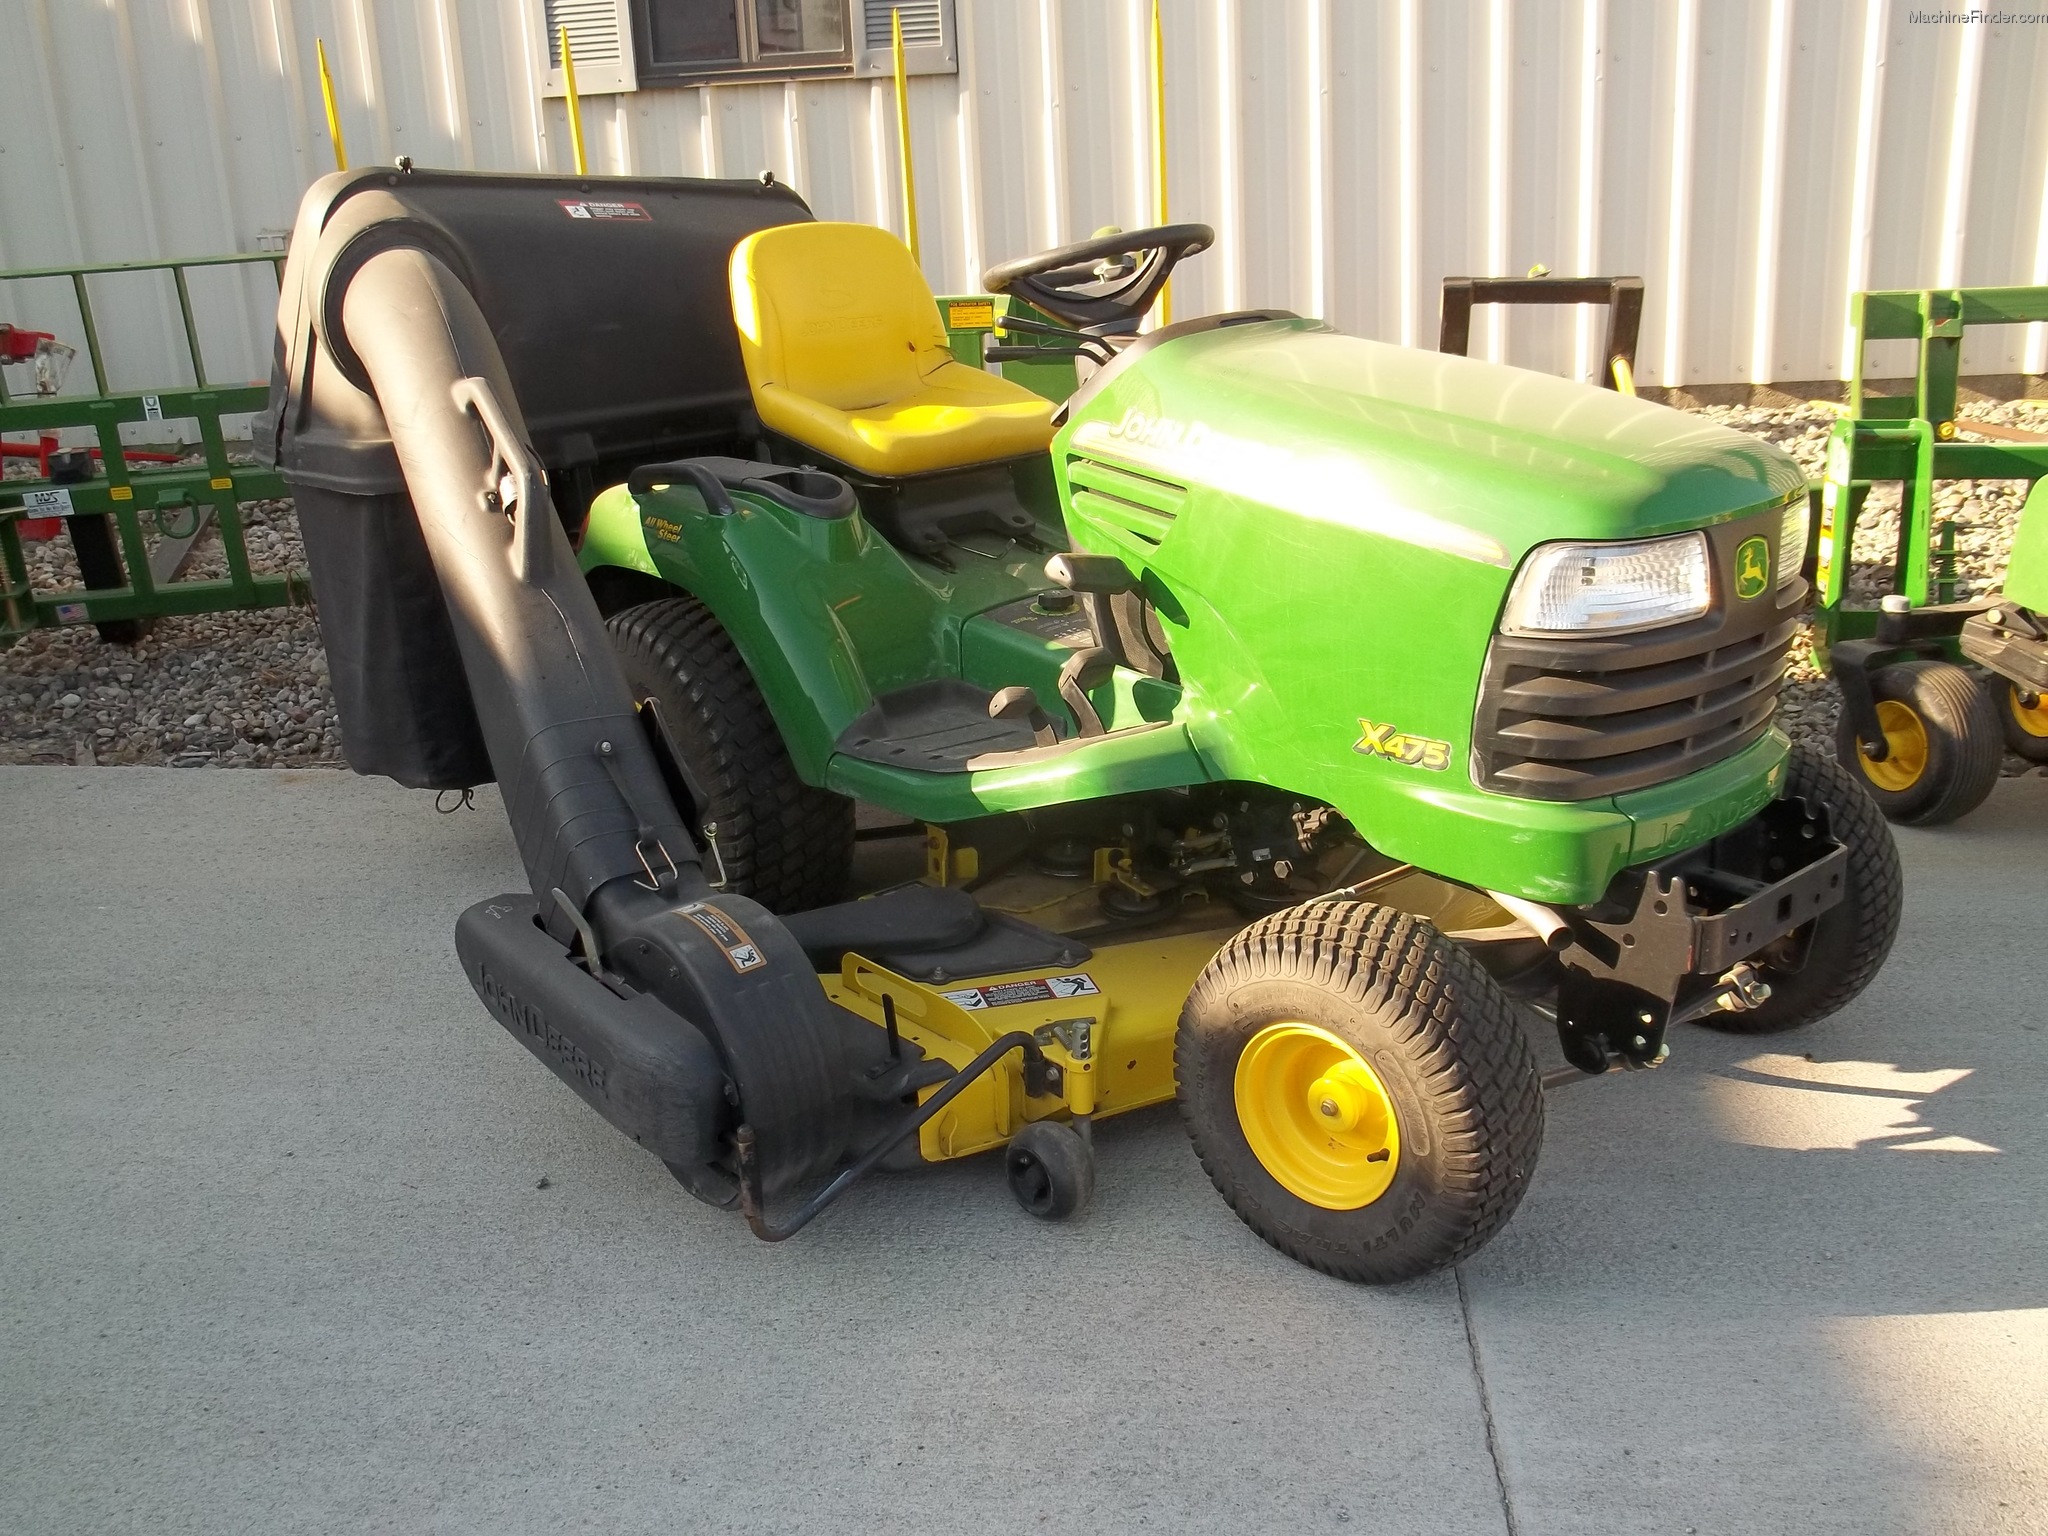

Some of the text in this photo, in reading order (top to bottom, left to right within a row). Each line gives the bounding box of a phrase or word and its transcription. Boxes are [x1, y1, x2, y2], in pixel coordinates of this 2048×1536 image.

[645, 516, 683, 534] All Wheel
[657, 529, 681, 543] Steer
[1352, 718, 1451, 771] X475
[475, 962, 524, 1026] JOHN
[998, 980, 1037, 990] DANGER
[1272, 1218, 1350, 1255] TRAC
[1363, 1191, 1427, 1254] MULTI
